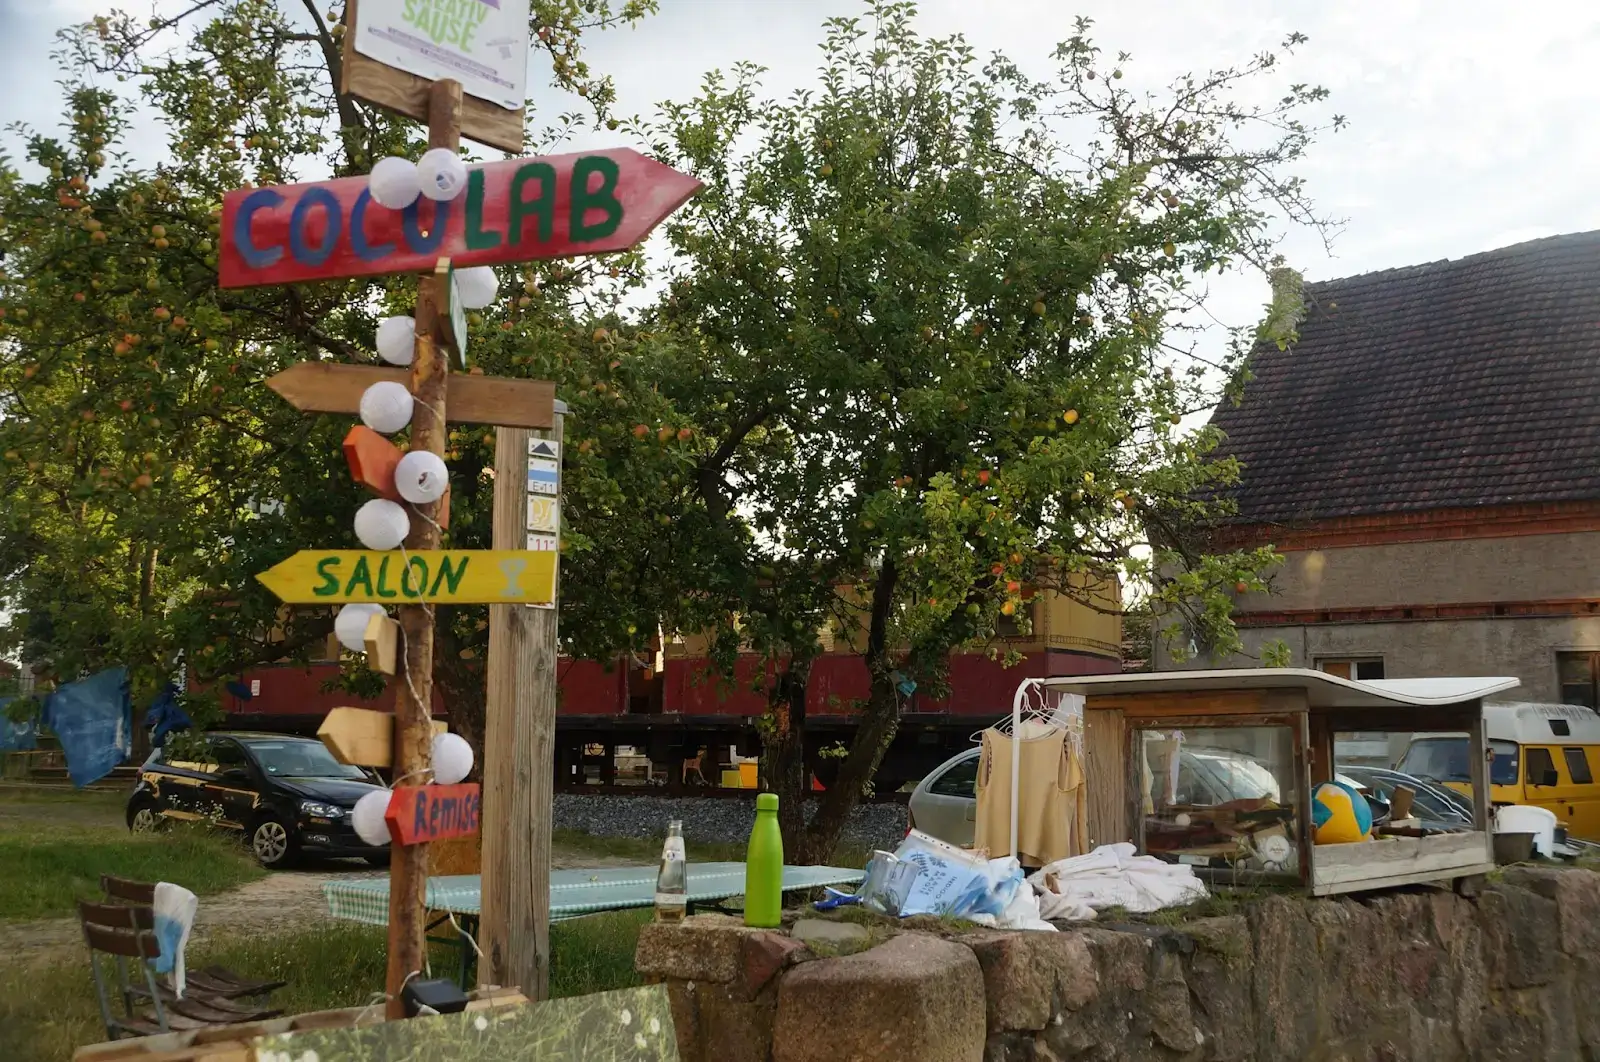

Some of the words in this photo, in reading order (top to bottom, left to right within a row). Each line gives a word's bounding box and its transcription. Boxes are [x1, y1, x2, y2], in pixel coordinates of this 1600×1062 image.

[402, 0, 478, 53] SAUSE
[312, 555, 470, 598] SALON
[935, 875, 958, 899] INDIGO
